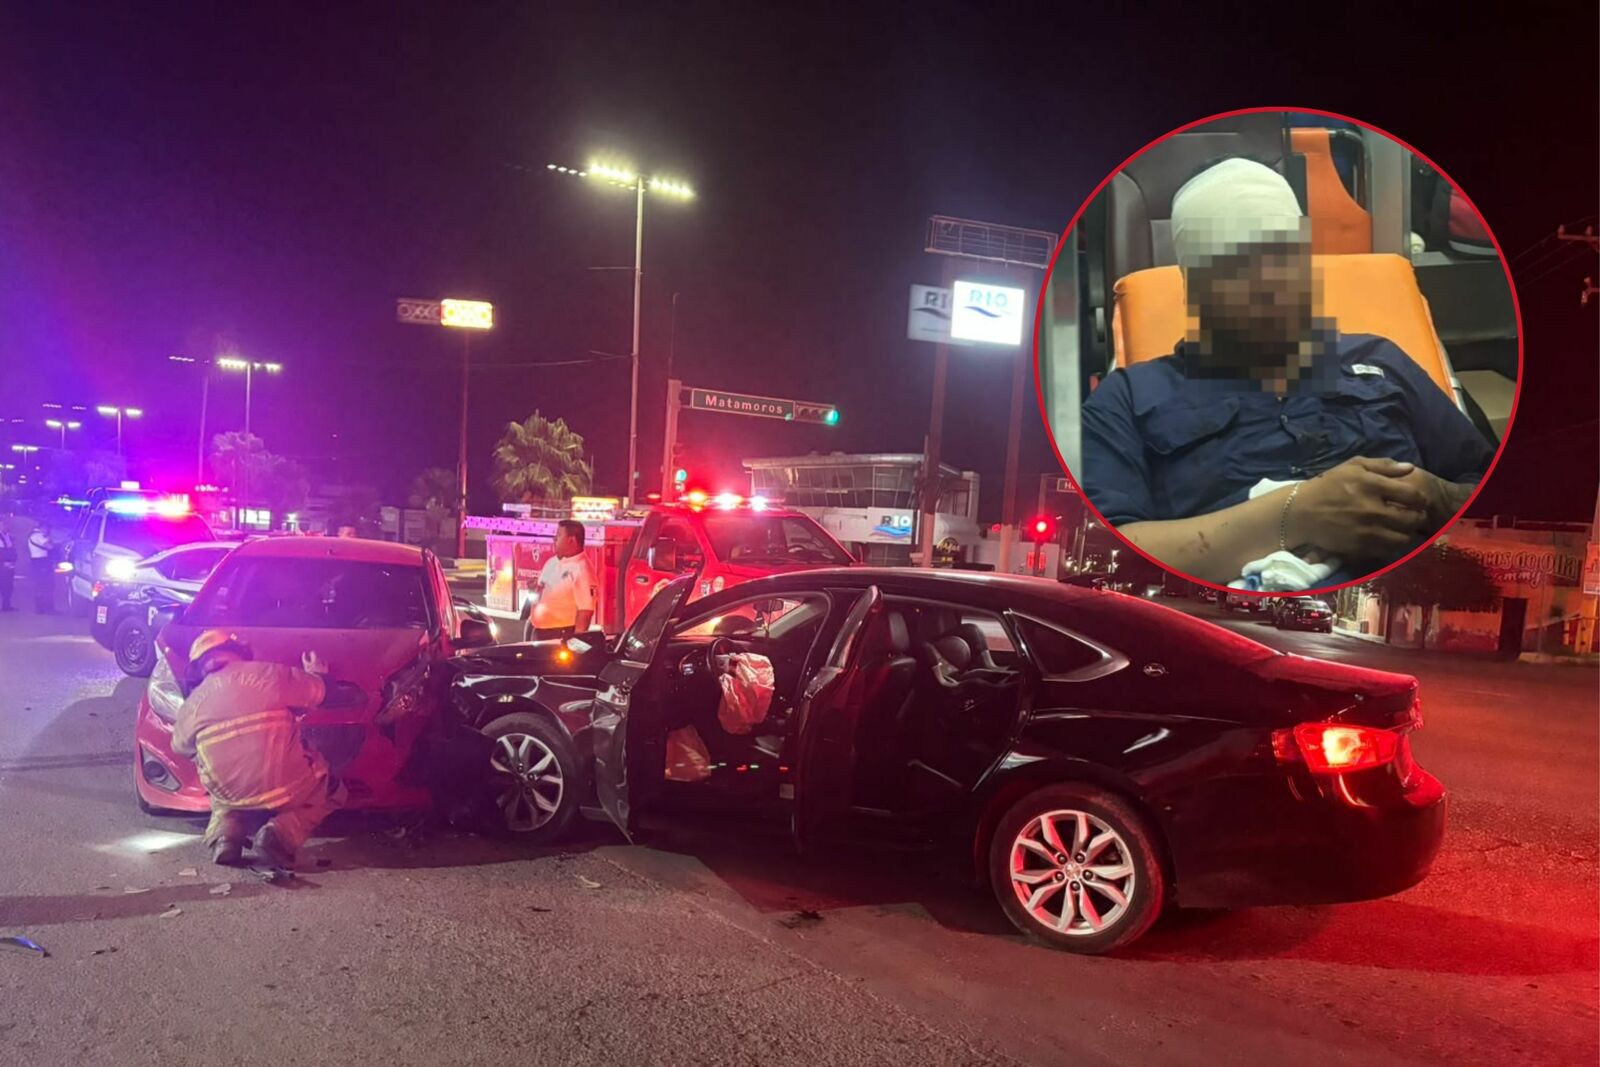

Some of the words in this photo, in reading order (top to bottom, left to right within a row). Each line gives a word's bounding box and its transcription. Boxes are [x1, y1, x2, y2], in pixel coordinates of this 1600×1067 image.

[924, 290, 950, 309] RI
[969, 289, 1008, 308] RIO
[705, 394, 783, 414] Matamoros
[882, 515, 912, 527] RIO
